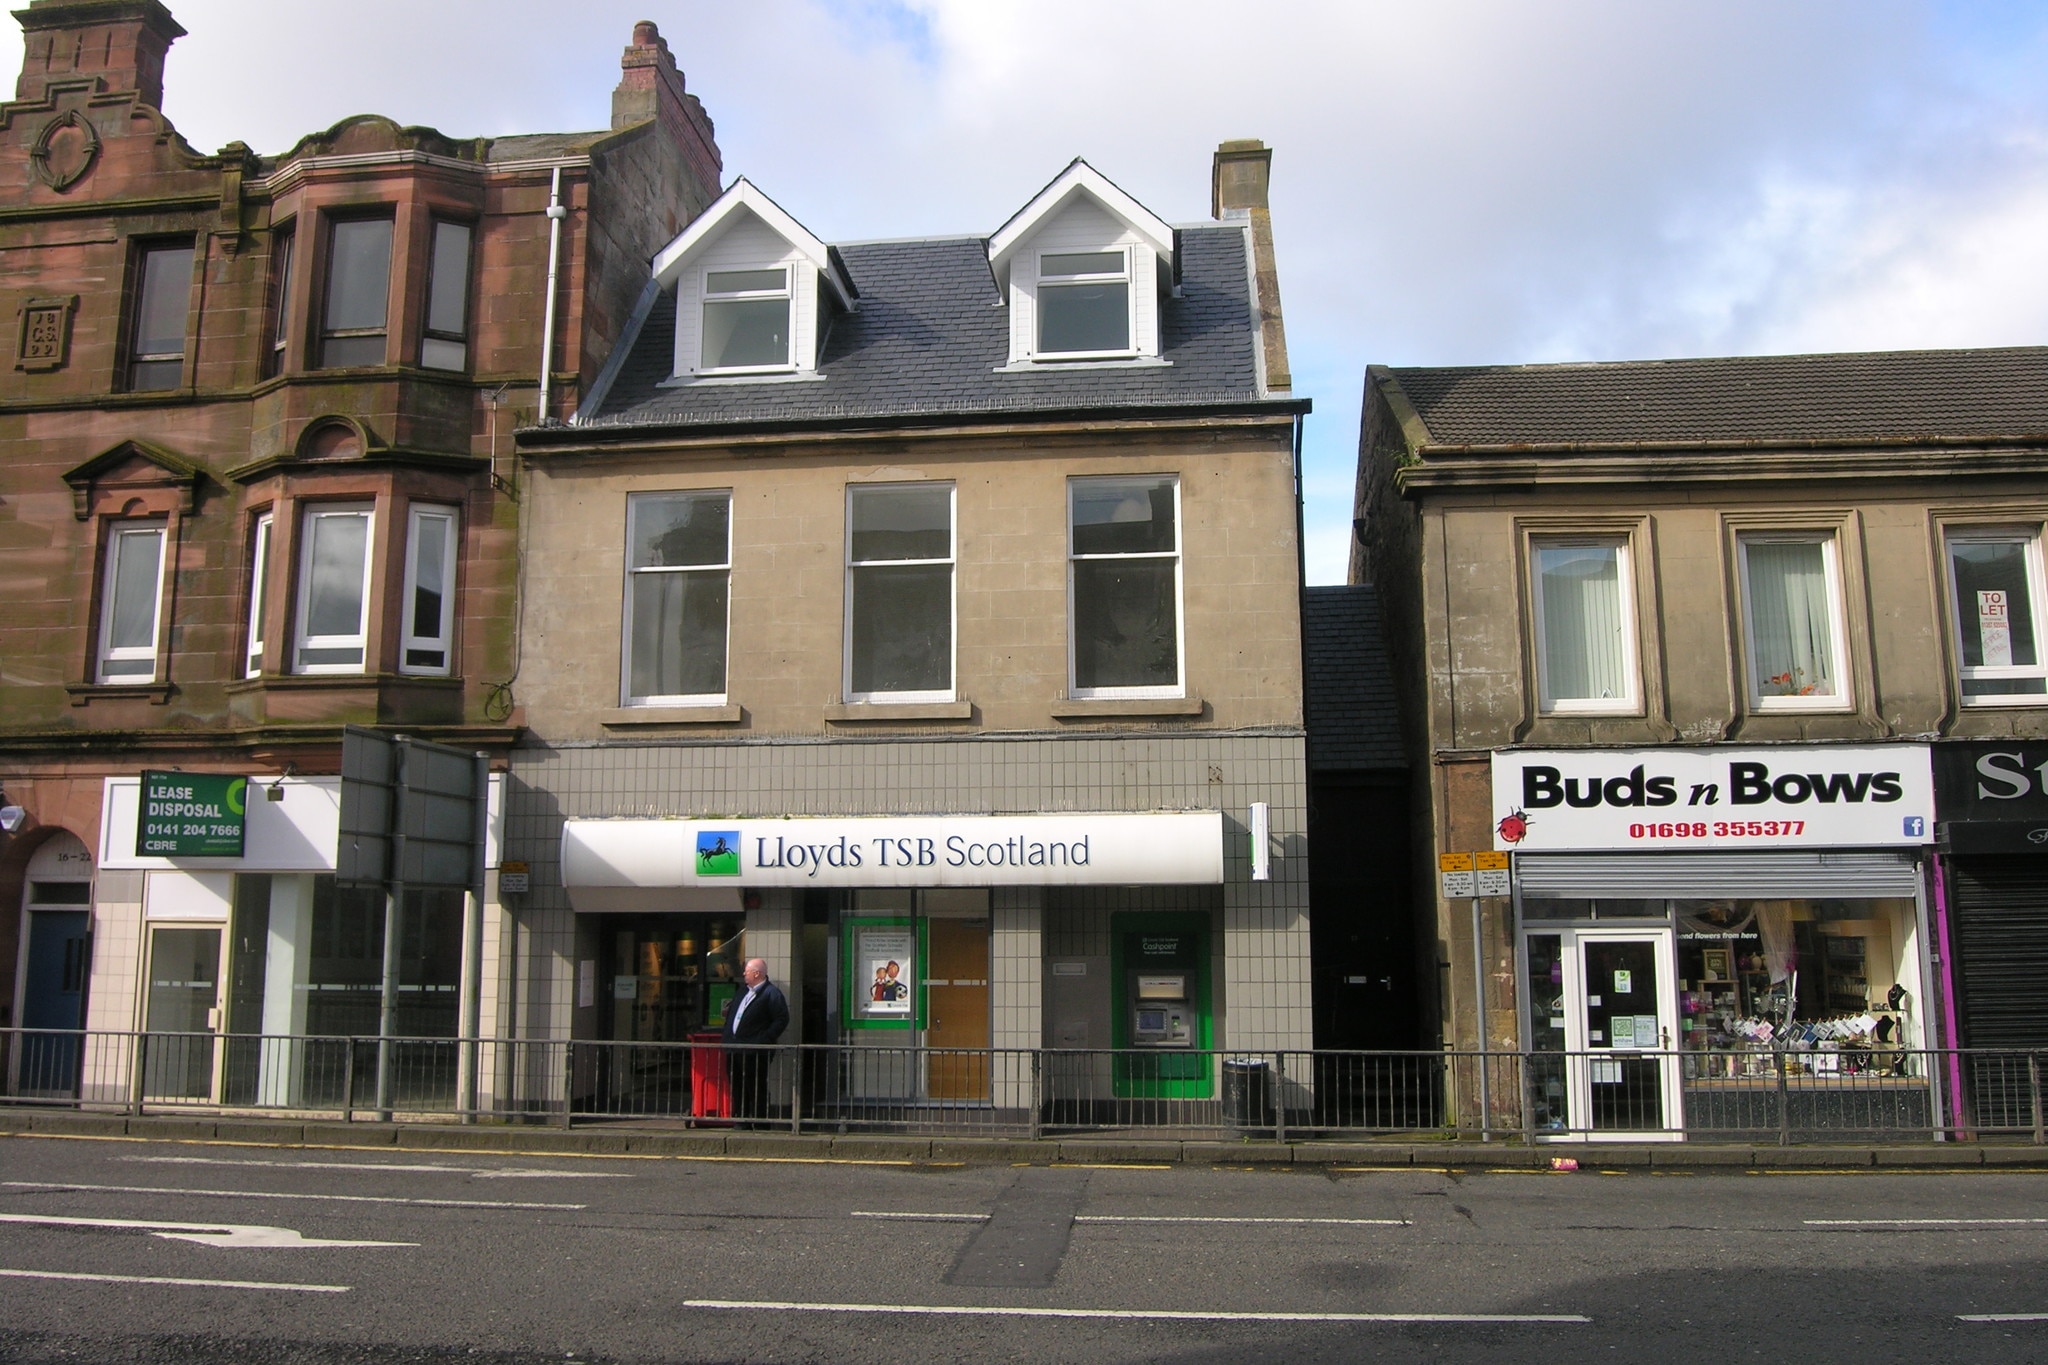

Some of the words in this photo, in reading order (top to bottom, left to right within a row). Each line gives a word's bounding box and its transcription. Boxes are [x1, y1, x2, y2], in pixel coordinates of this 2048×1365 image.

[1982, 592, 2002, 604] TO
[1980, 604, 2006, 616] LET
[1521, 763, 1678, 808] Buds
[1687, 783, 1719, 806] n
[1729, 761, 1903, 806] Bows
[149, 786, 193, 799] LEASE
[148, 802, 222, 818] DISPOSAL
[147, 823, 178, 835] 0141
[183, 824, 207, 836] 204
[210, 825, 240, 836] 7666
[1629, 821, 1707, 839] 01698
[1713, 820, 1805, 837] 355377
[145, 840, 177, 851] CBRE
[755, 835, 862, 877] Lloyds
[872, 837, 935, 867] TSB
[945, 834, 1090, 866] Scotland
[1694, 932, 1721, 940] flowers
[1722, 932, 1740, 940] from
[1740, 932, 1758, 940] here
[1142, 942, 1177, 951] Cashpoint
